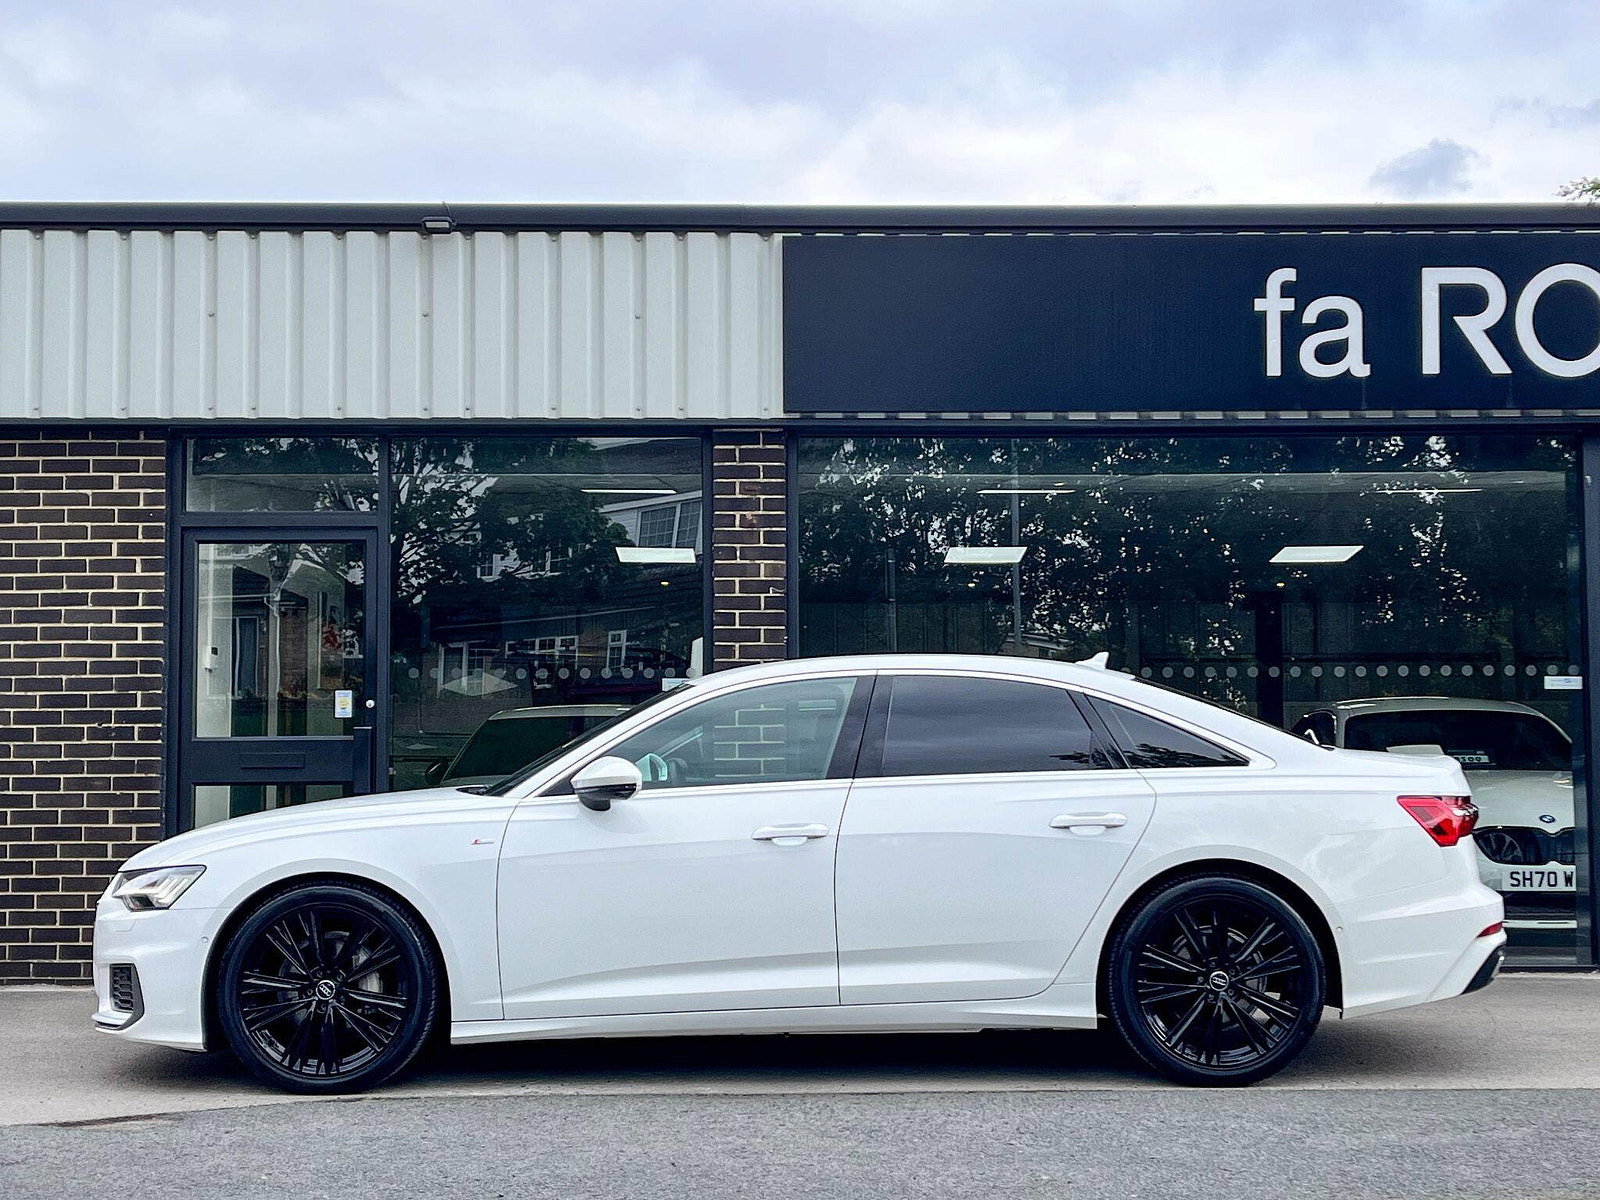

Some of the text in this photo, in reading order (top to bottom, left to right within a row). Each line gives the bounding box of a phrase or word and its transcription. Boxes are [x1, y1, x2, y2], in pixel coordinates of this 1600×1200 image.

[1254, 263, 1600, 377] fa RO
[1509, 871, 1557, 887] SH70
